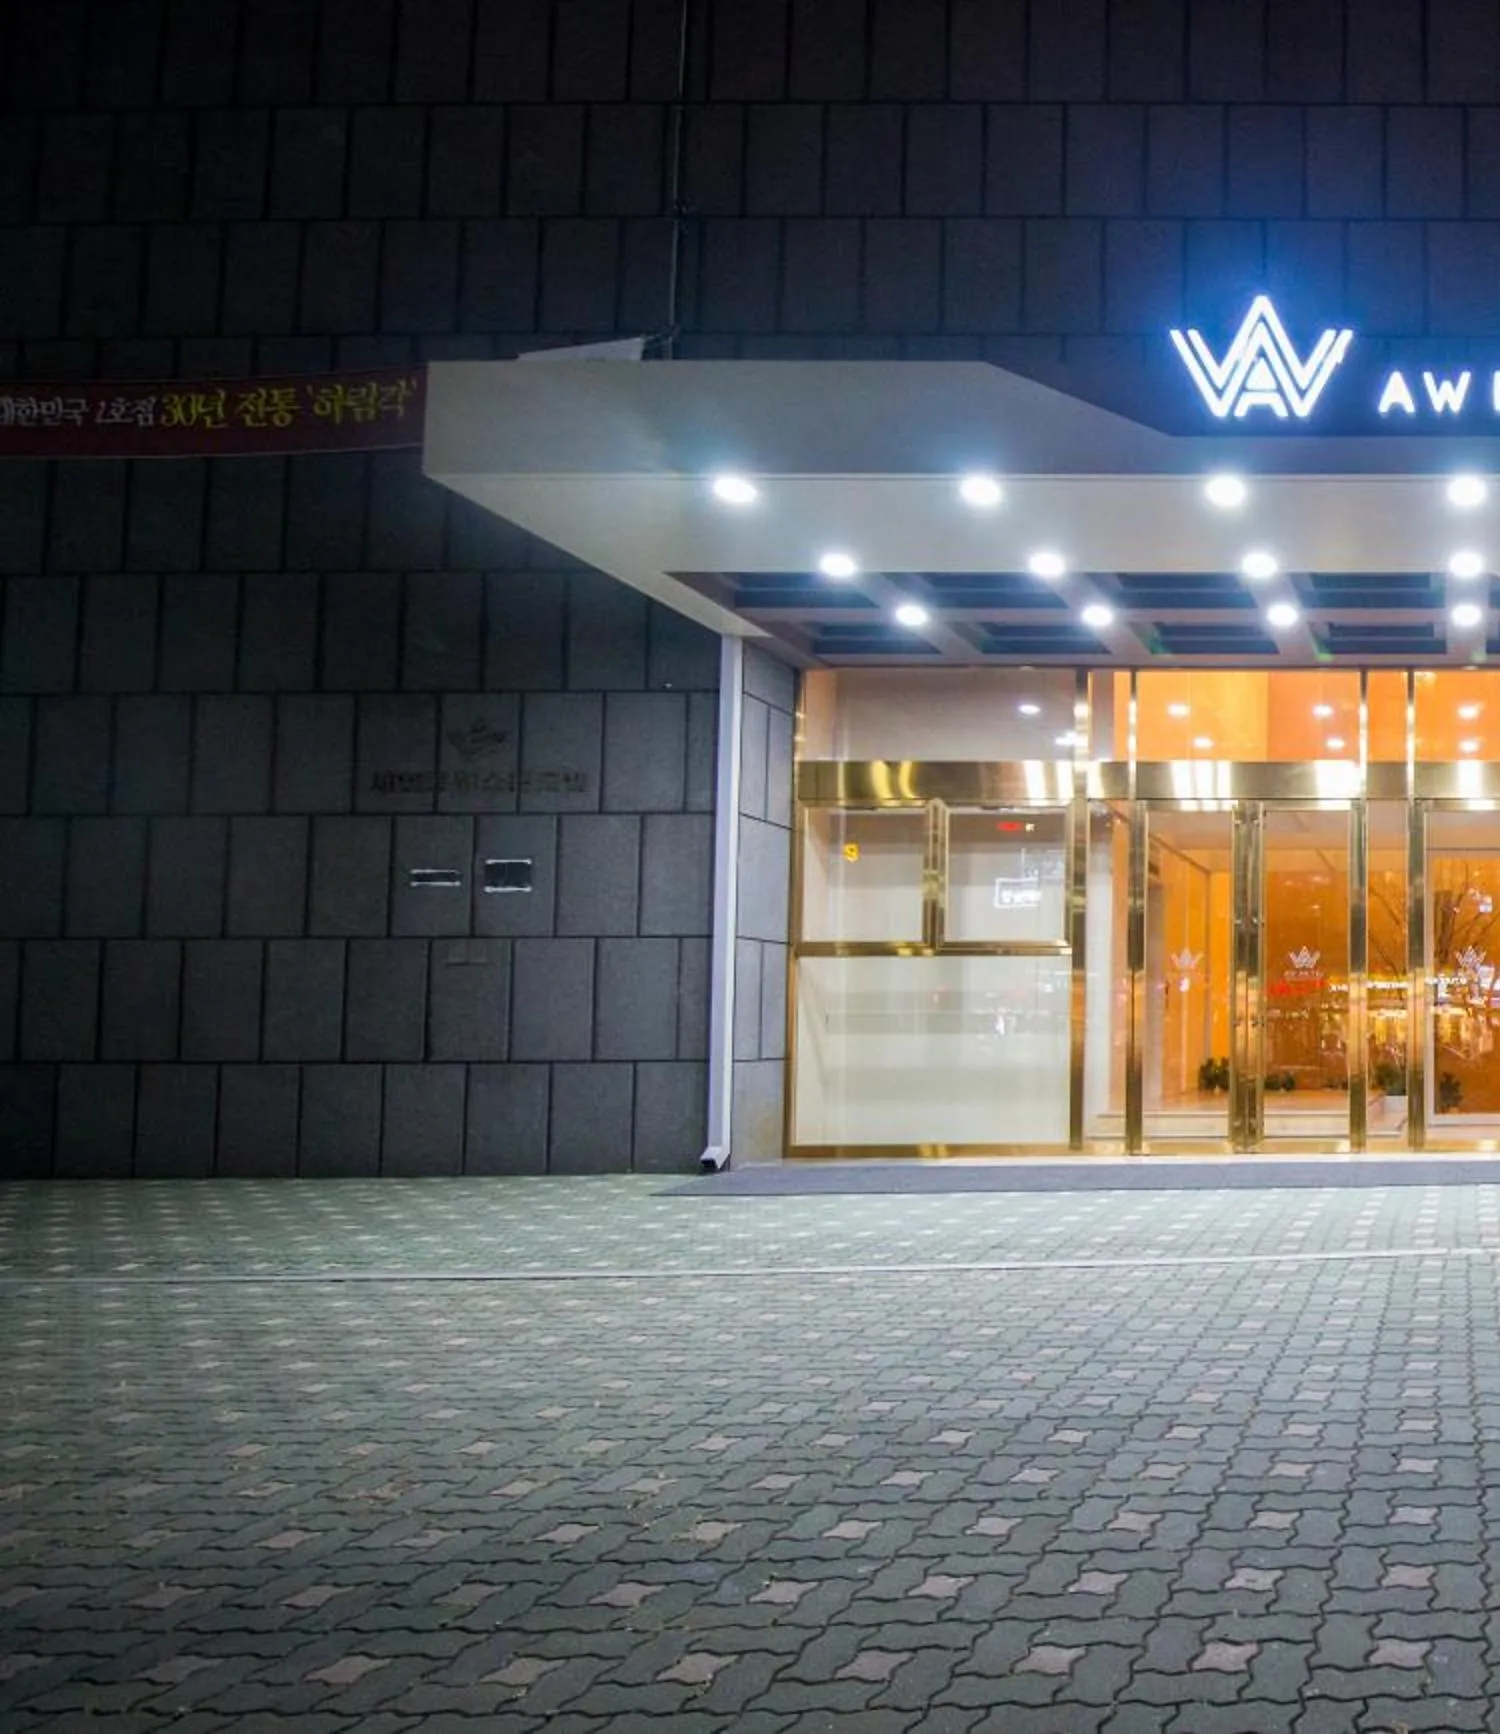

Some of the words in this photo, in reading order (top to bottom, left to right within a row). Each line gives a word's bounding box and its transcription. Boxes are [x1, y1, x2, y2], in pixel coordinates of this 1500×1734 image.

[159, 388, 227, 430] 30년
[236, 386, 302, 429] 전통
[1377, 371, 1471, 414] AW
